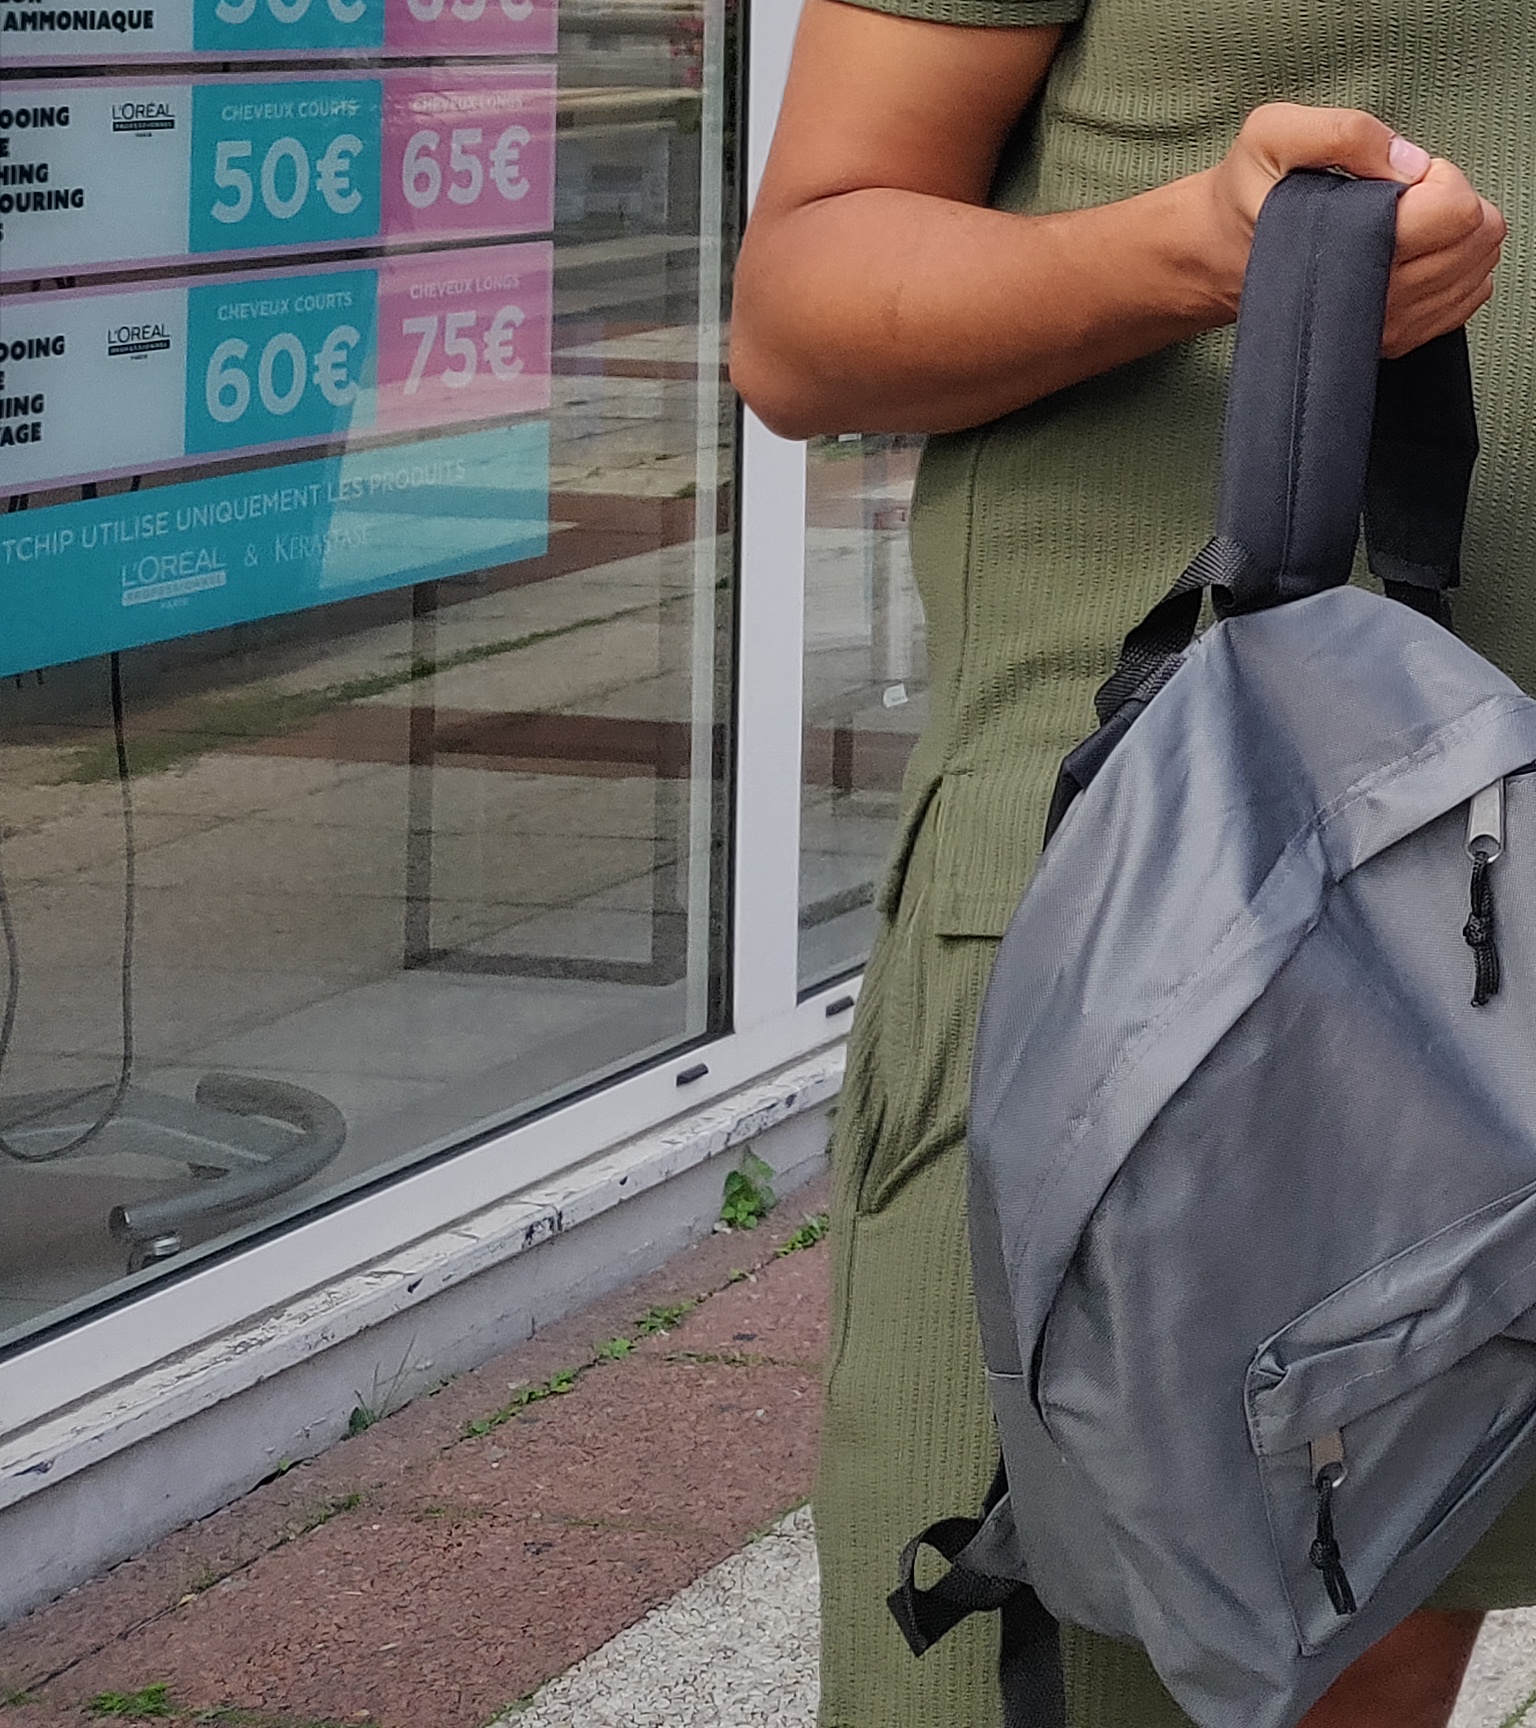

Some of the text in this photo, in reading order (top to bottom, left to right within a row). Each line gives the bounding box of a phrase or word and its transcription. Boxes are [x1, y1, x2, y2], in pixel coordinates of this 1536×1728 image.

[3, 10, 154, 33] AMMONIAQUE
[221, 100, 294, 122] CHEVEUX
[210, 133, 363, 223] 50€
[402, 125, 531, 208] 65€
[410, 280, 471, 299] CHEVEUX
[217, 292, 352, 321] CHEVEUX COURTS
[402, 305, 525, 396] 75€
[205, 324, 361, 423] 60€
[0, 422, 42, 447] AGE
[2, 459, 465, 564] TCHIP UTILISE UNIQUEMENT LES PRODUITS
[244, 544, 258, 566] &
